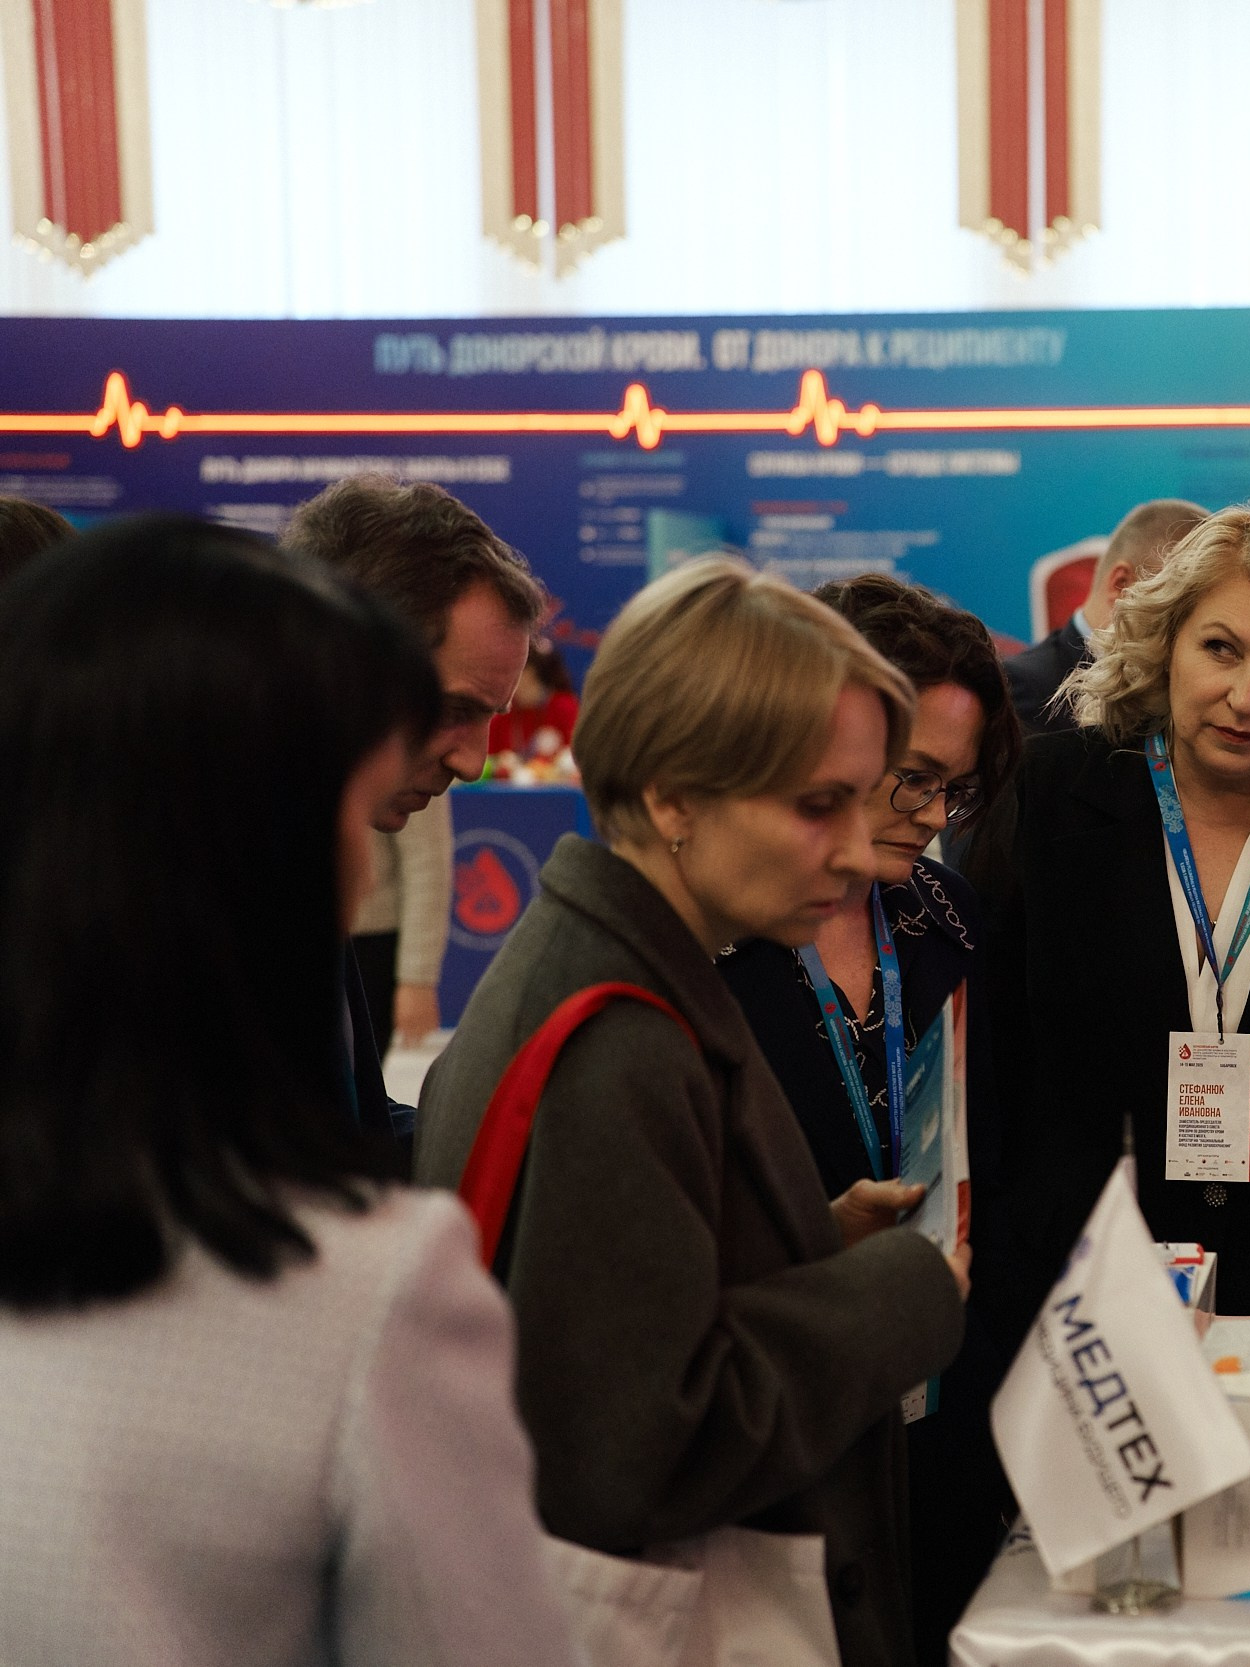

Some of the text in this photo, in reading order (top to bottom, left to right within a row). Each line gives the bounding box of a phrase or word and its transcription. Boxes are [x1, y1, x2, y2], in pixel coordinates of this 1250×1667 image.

[1179, 1084, 1224, 1095] СТЕФАНЮК
[1179, 1095, 1205, 1106] ЕЛЕНА
[1179, 1107, 1221, 1118] ИВАНОВНА
[1053, 1294, 1173, 1503] МЕДТЕХ
